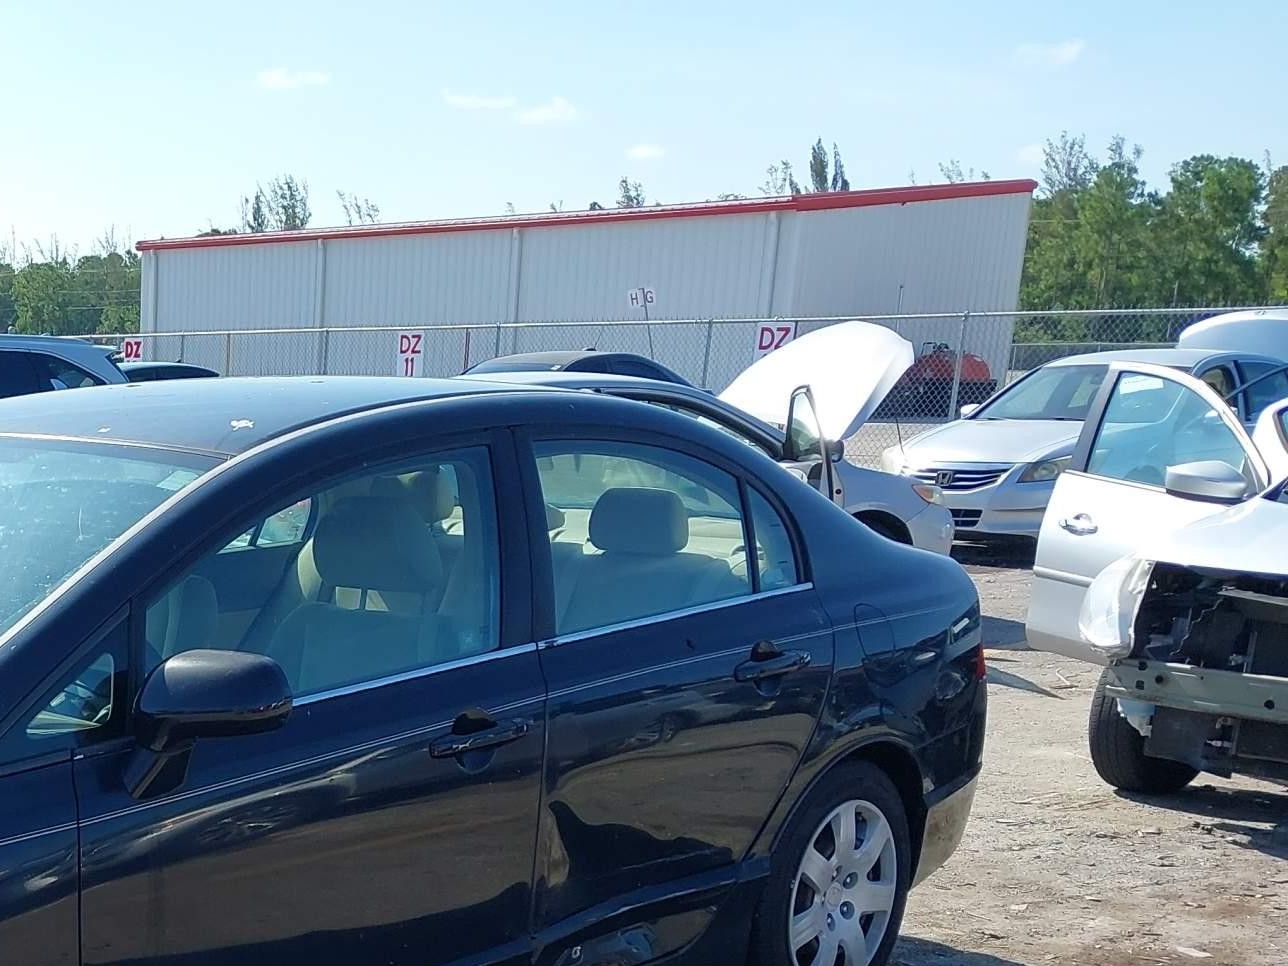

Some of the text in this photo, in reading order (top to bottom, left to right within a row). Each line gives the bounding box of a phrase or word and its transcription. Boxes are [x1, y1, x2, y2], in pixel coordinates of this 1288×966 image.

[399, 334, 422, 354] DZ
[758, 326, 792, 350] DZ
[124, 341, 142, 358] DZ
[404, 357, 414, 377] 11
